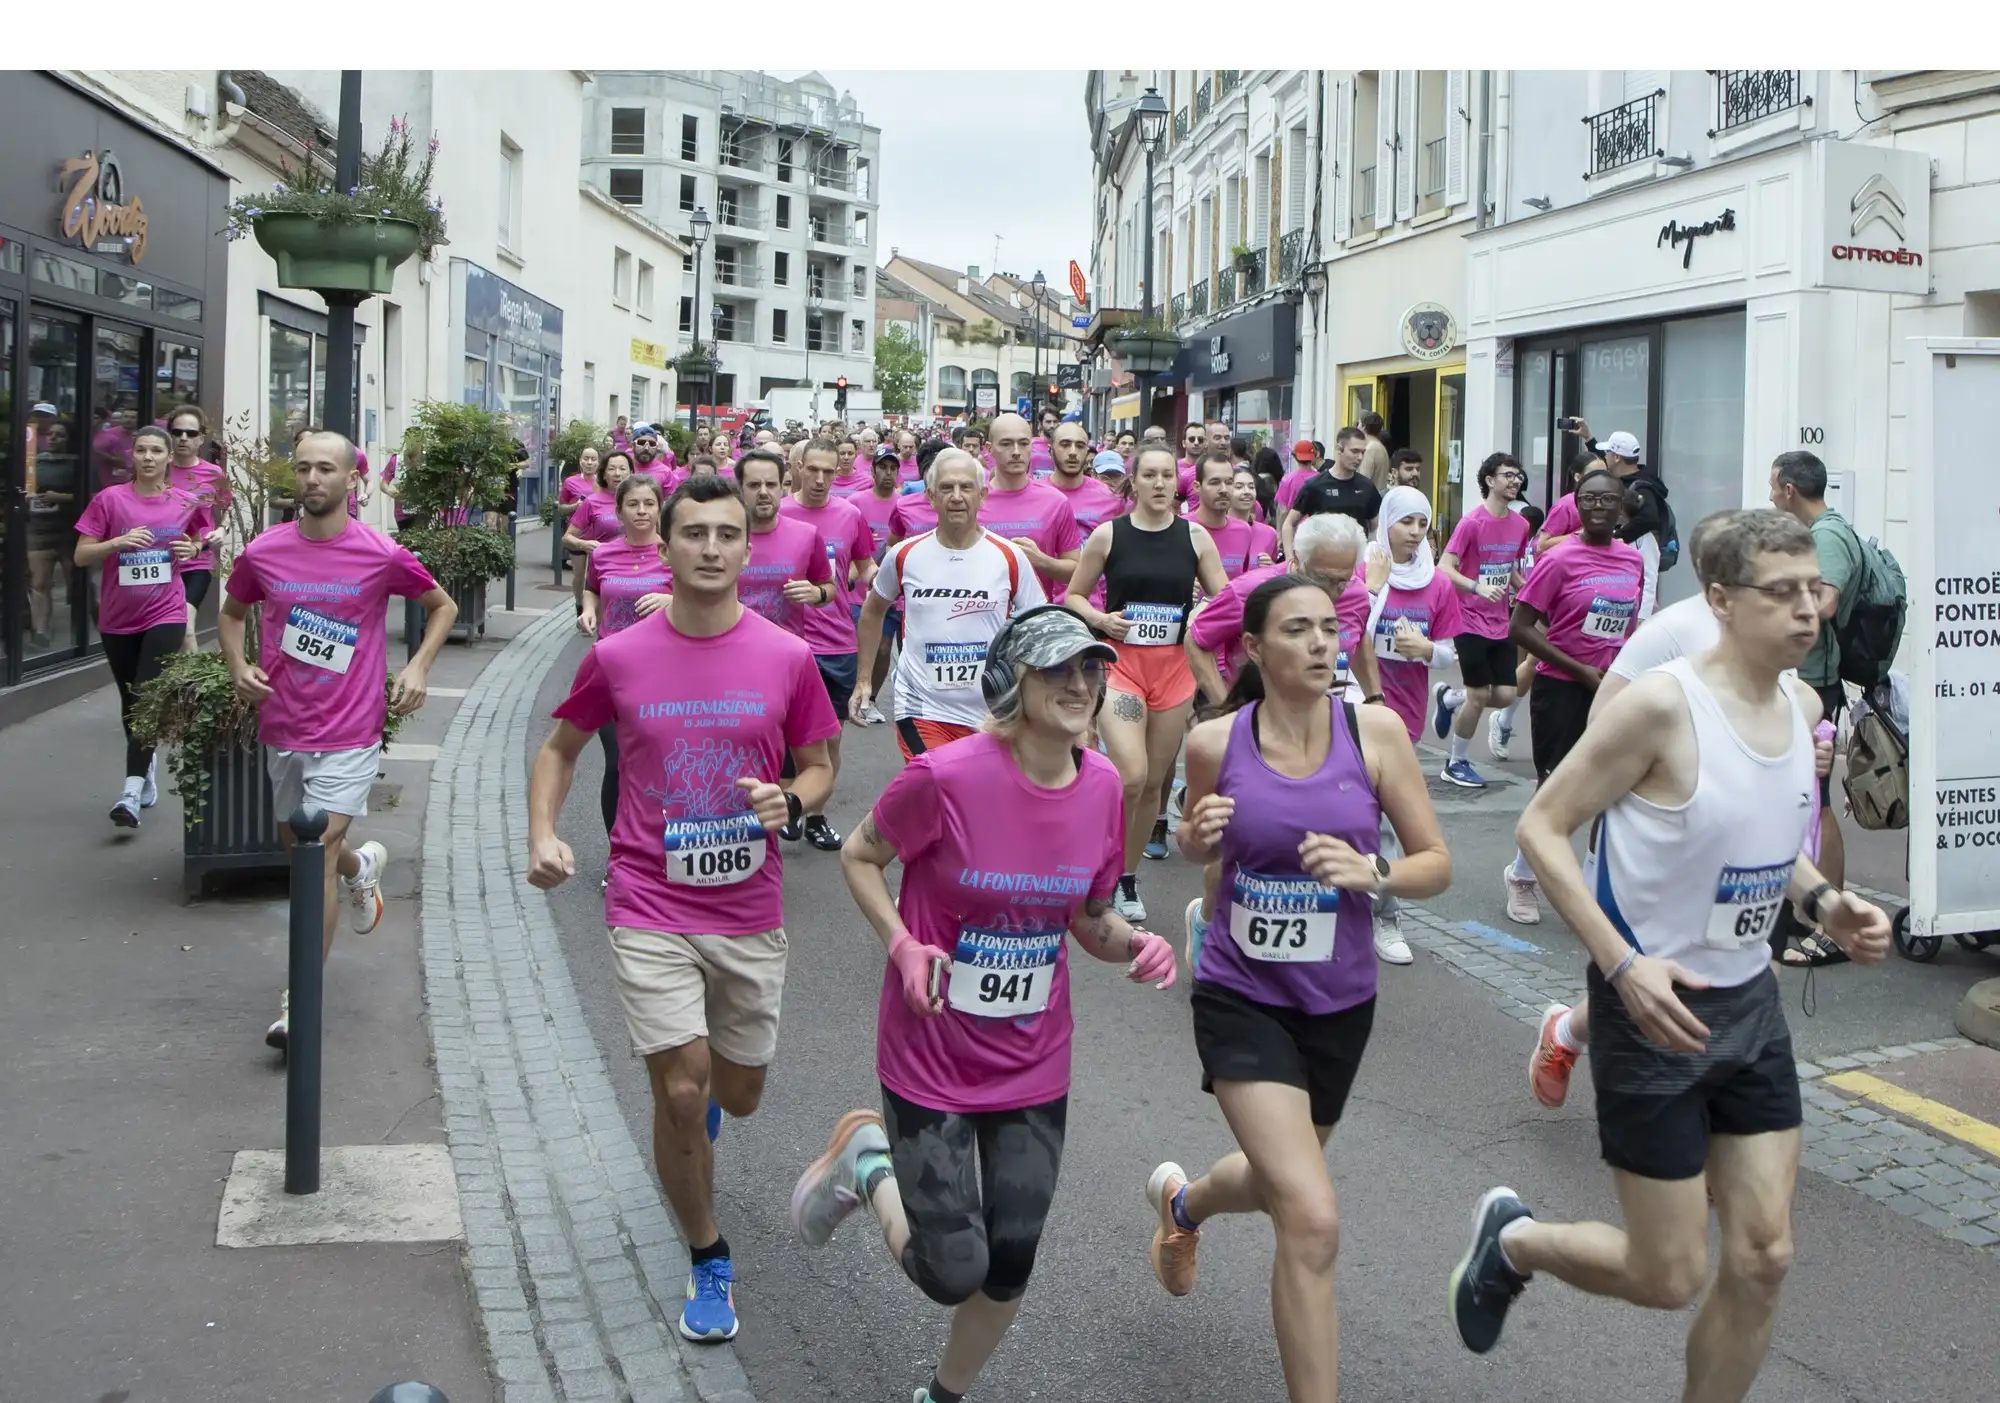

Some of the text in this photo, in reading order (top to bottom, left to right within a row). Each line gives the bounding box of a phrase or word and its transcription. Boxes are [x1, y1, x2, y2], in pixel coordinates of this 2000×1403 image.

[1411, 345, 1426, 358] GAIA
[1800, 427, 1824, 444] 100
[131, 566, 160, 580] 918
[291, 605, 301, 617] LA
[1935, 603, 2000, 622] FONTE
[1138, 624, 1168, 639] 805
[1595, 617, 1625, 633] 1024
[296, 633, 336, 661] 954
[935, 665, 978, 682] 1127
[1970, 682, 1985, 696] 01
[639, 699, 767, 719] LA FONTENAISIENNE
[1936, 787, 1996, 805] VENTES
[665, 814, 760, 836] LA FONTENAISIENN
[1936, 807, 2000, 828] VÉHICU
[1936, 834, 1948, 850] &
[682, 846, 752, 877] 1086
[959, 868, 978, 889] LA
[1734, 901, 1780, 937] 657
[960, 931, 976, 946] LA
[1248, 916, 1308, 948] 673
[979, 973, 1034, 1003] 941
